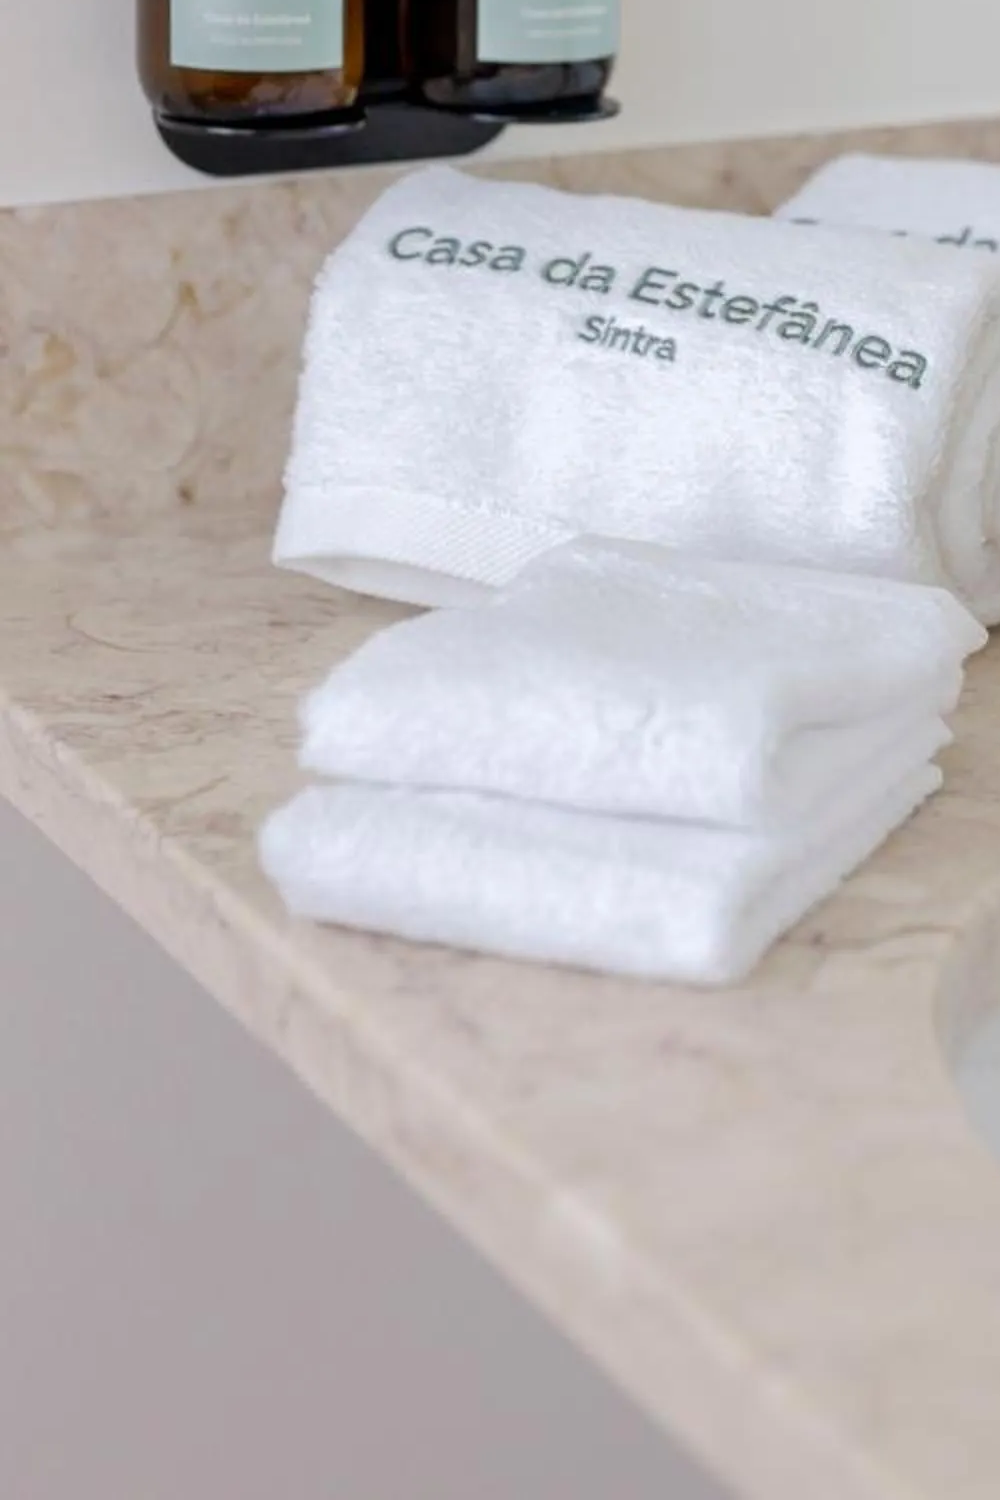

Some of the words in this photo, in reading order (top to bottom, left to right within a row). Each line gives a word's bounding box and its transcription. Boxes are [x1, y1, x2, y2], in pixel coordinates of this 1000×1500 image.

[387, 225, 526, 274] Casa
[540, 250, 618, 295] da
[628, 265, 930, 389] Estefânea
[577, 314, 678, 363] Sintra
